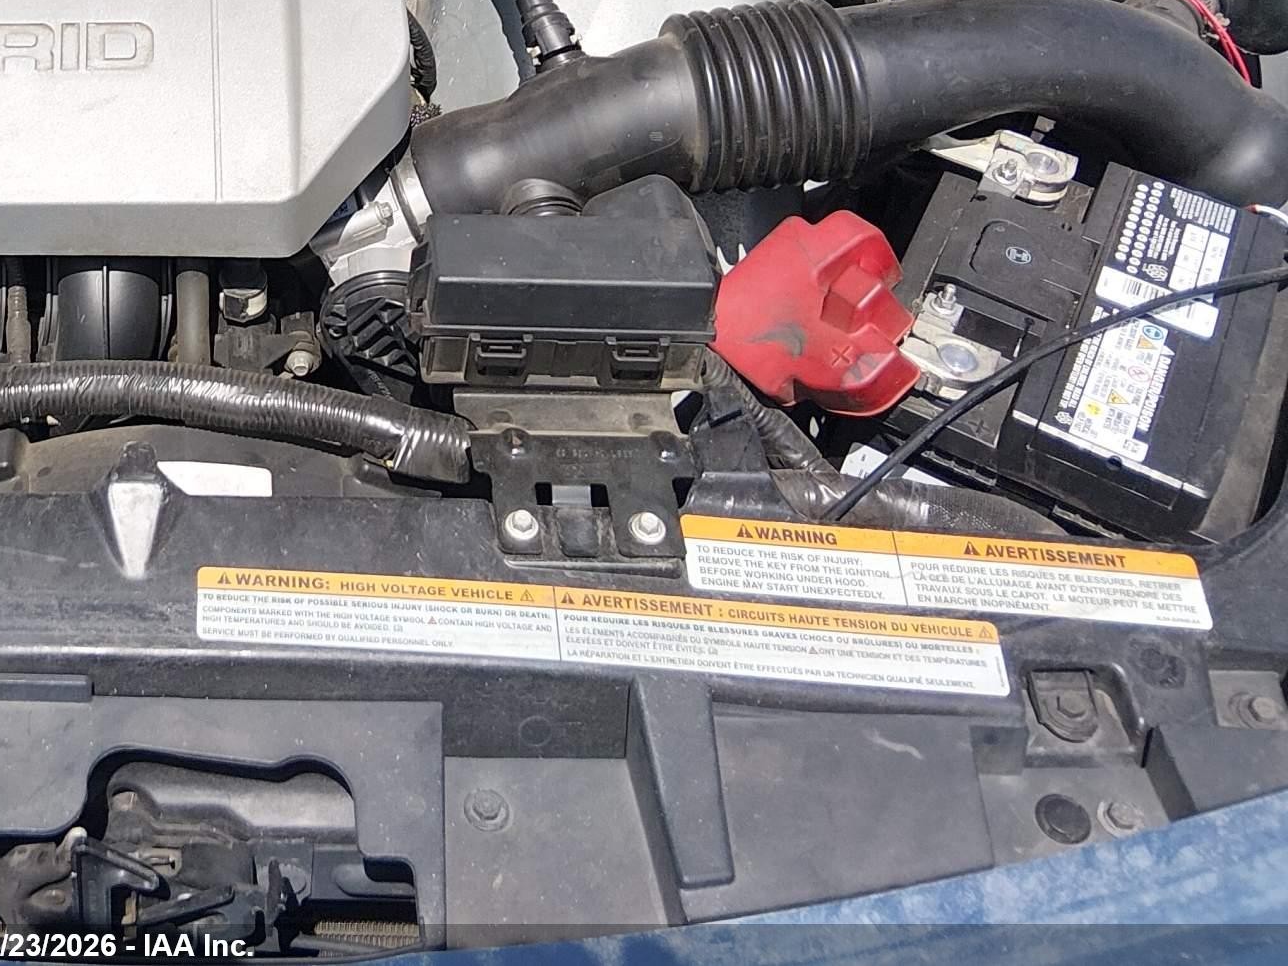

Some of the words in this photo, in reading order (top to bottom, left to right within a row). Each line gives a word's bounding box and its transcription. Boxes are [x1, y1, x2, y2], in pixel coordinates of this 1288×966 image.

[755, 527, 837, 544] WARNING
[696, 545, 710, 553] TO
[712, 546, 754, 557] REDUCE
[758, 550, 777, 559] THE
[780, 551, 804, 561] RISK
[806, 554, 820, 562] OF
[698, 555, 741, 566] REMOVE
[743, 559, 763, 568] THE
[767, 561, 787, 570] KEY
[790, 563, 820, 572] FROM
[823, 565, 842, 574] THE
[984, 544, 1127, 567] AVERTISSEMENT
[235, 573, 329, 589] WARNING:
[340, 580, 375, 592] HIGH
[381, 583, 445, 596] VOLTAGE
[450, 587, 513, 600] VEHICLE
[699, 566, 741, 576] BEFORE
[743, 570, 793, 581] WORKING
[796, 574, 832, 584] UNDER
[910, 561, 939, 570] POUR
[989, 568, 1008, 576] LES
[1011, 570, 1055, 580] RISQUES
[1058, 573, 1072, 581] DE
[1138, 580, 1181, 590] RETIRER
[912, 572, 926, 580] LA
[951, 575, 966, 583] DE
[1034, 582, 1067, 591] AVANT
[1161, 592, 1182, 601] DES
[701, 577, 740, 587] ENGINE
[742, 580, 762, 589] MAY
[766, 582, 798, 592] START
[801, 585, 885, 599] UNEXPECTEDLY.
[915, 583, 961, 593] TRAVAUX
[964, 587, 993, 596] SOUS
[1052, 594, 1065, 602] LE
[1067, 595, 1112, 605] MOTEUR
[1156, 603, 1197, 612] METTRE
[916, 593, 931, 601] EN
[934, 595, 977, 605] MARCHE
[216, 592, 249, 601] REDUCE
[253, 595, 267, 603] THE
[271, 596, 291, 604] RISK
[294, 597, 304, 605] OF
[307, 598, 348, 607] POSSIBLE
[351, 600, 387, 610] SERIOUS
[391, 603, 422, 612] INJURY
[504, 609, 516, 617] OR
[582, 594, 712, 616] AVERTISSEMENT
[727, 608, 785, 622] CIRCUITS
[788, 613, 829, 626] HAUTE
[832, 617, 888, 630] TENSION
[890, 621, 909, 632] DU
[202, 604, 256, 614] COMPONENTS
[258, 607, 291, 616] MARKED
[294, 609, 313, 618] WITH
[316, 610, 330, 619] THE
[333, 611, 352, 620] HIGH
[354, 613, 389, 622] VOLTAGE
[393, 615, 424, 624] SYMBOL
[438, 617, 472, 627] CONTAIN
[474, 620, 494, 628] HIGH
[497, 621, 532, 630] VOLTAGE
[535, 623, 552, 632] AND
[203, 613, 221, 622] HIGH
[224, 615, 285, 625] TEMPERATURES
[287, 618, 304, 627] AND
[307, 620, 338, 629] SHOULD
[203, 626, 235, 635] SERVICE
[238, 628, 258, 637] MUST
[274, 630, 323, 641] PERFORMED
[325, 633, 335, 641] BY
[338, 634, 379, 644] QUALIFIED
[381, 637, 428, 647] PERSONNEL
[563, 614, 587, 622] POUR
[632, 619, 649, 627] LES
[652, 621, 690, 630] RISQUES
[707, 625, 758, 636] BLESSURES
[761, 630, 797, 639] GRAVES
[799, 633, 833, 642] (CHOCS
[920, 642, 973, 653] MORTELLES
[566, 634, 601, 645] ÉLEVÉES
[615, 640, 650, 648] DOIVENT
[652, 641, 672, 650] ÊTRE
[565, 626, 578, 634] LES
[582, 626, 624, 638] ÉLÉMENTS
[627, 630, 687, 643] ACCOMPAGNÉS
[689, 636, 701, 644] DU
[703, 637, 740, 647] SYMBOLE
[743, 641, 770, 650] HAUTE
[772, 643, 806, 652] TENSION
[818, 647, 835, 655] ONT
[837, 648, 854, 656] UNE
[856, 650, 890, 659] TENSION
[904, 654, 920, 662] DES
[922, 653, 986, 667] TEMPÉRATURES
[567, 648, 577, 656] LA
[579, 648, 629, 660] RÉPARATION
[697, 659, 731, 668] DOIVENT
[733, 660, 753, 670] ÊTRE
[756, 662, 802, 674] EFFECTUÉS
[836, 670, 884, 681] TECHNICIEN
[886, 672, 923, 684] QUALIFIÉ
